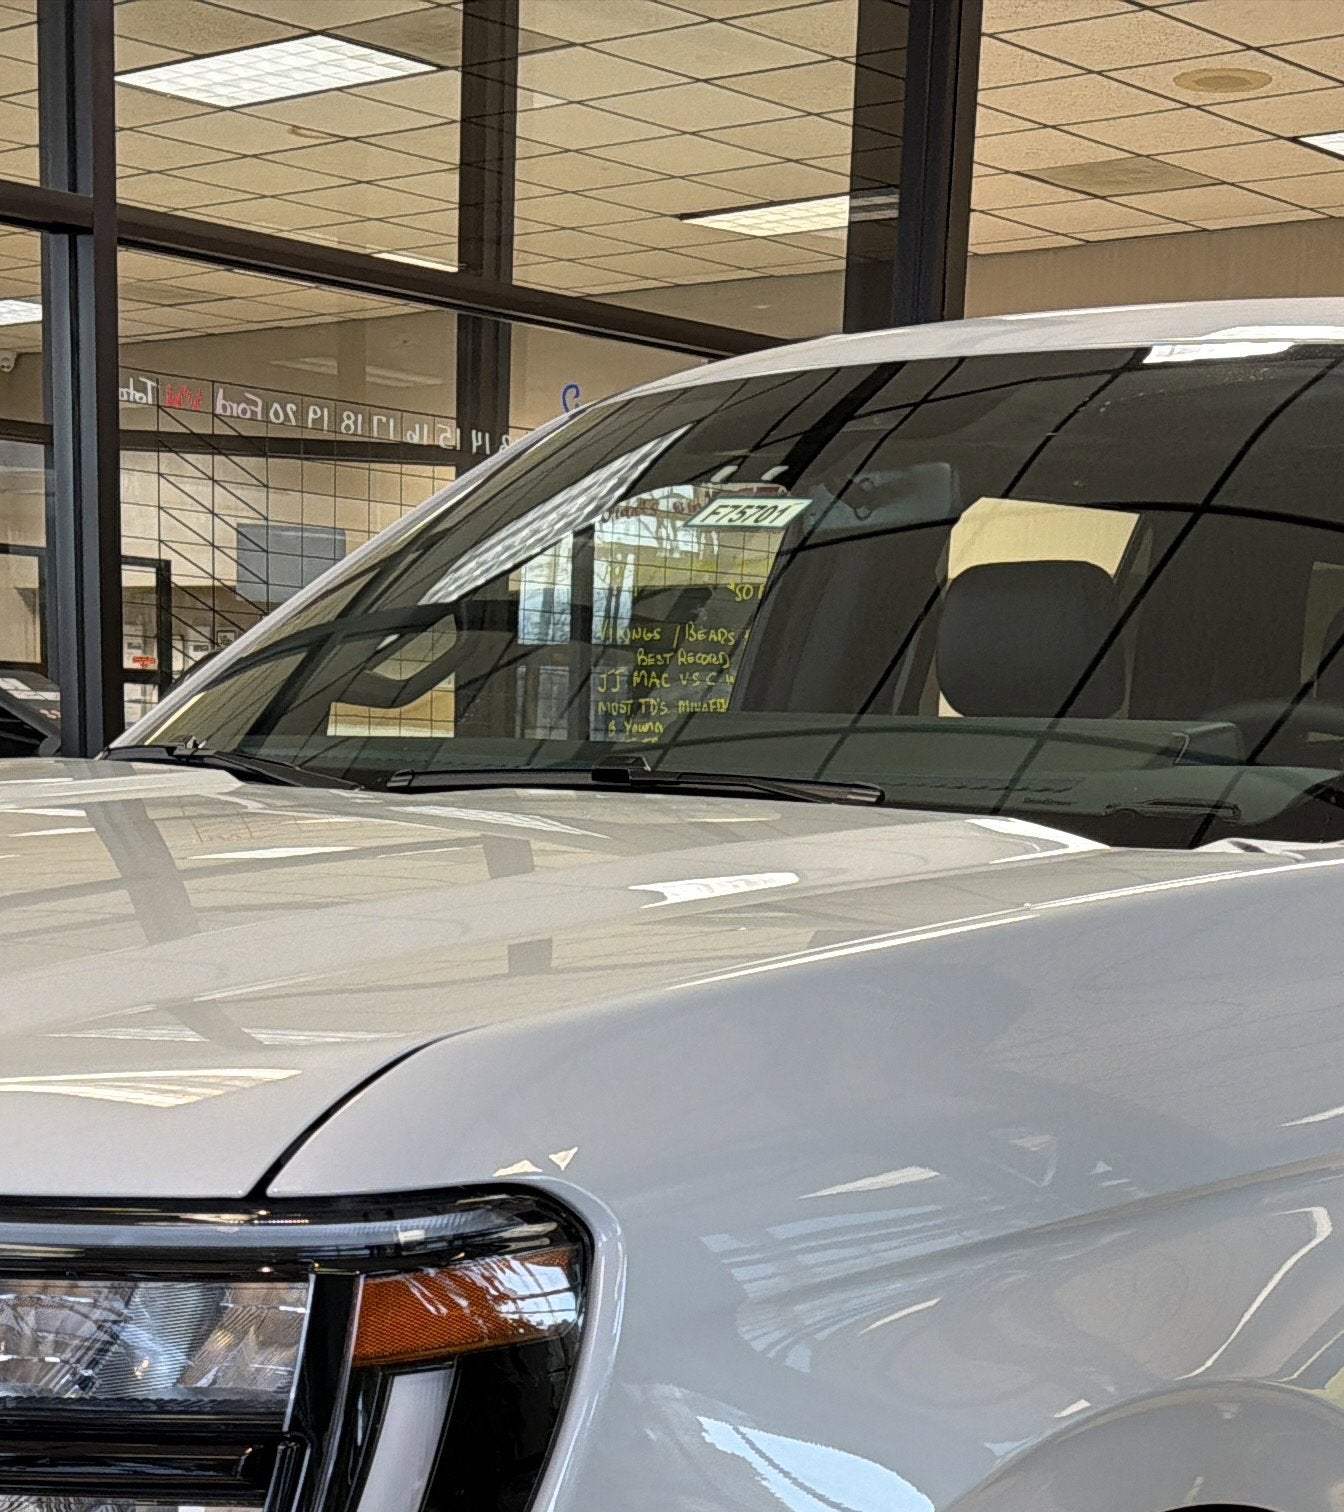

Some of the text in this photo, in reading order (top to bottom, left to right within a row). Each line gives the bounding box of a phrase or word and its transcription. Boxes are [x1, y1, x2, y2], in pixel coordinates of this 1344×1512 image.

[700, 504, 793, 525] F75701
[685, 621, 737, 646] BEARS
[637, 647, 731, 669] BEST RECORD
[632, 671, 671, 689] MAC
[597, 699, 634, 716] MOST
